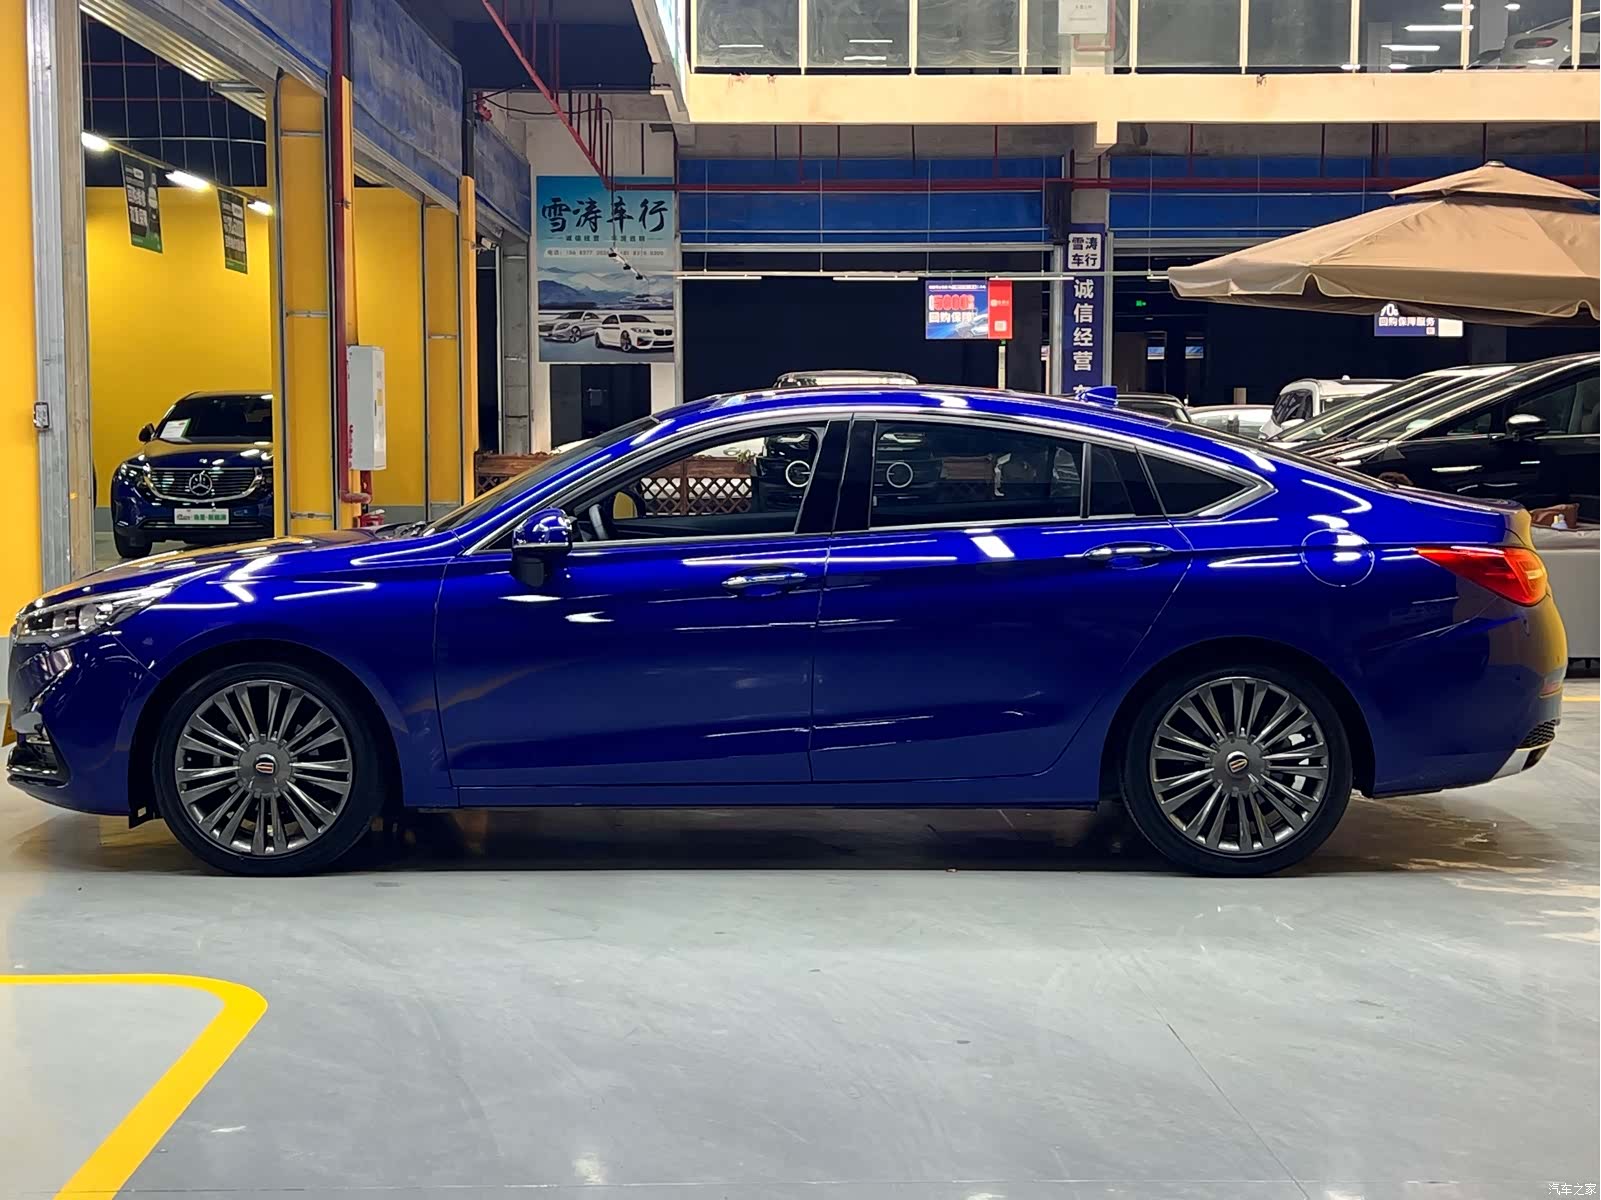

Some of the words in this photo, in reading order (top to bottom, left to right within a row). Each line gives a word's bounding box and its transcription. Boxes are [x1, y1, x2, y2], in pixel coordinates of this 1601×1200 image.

[541, 195, 669, 234] 雪涛车行
[1071, 236, 1098, 251] 雪涛
[1071, 253, 1098, 267] 车行
[1073, 279, 1095, 372] 诚信经营
[1379, 316, 1435, 327] 回购保障服务
